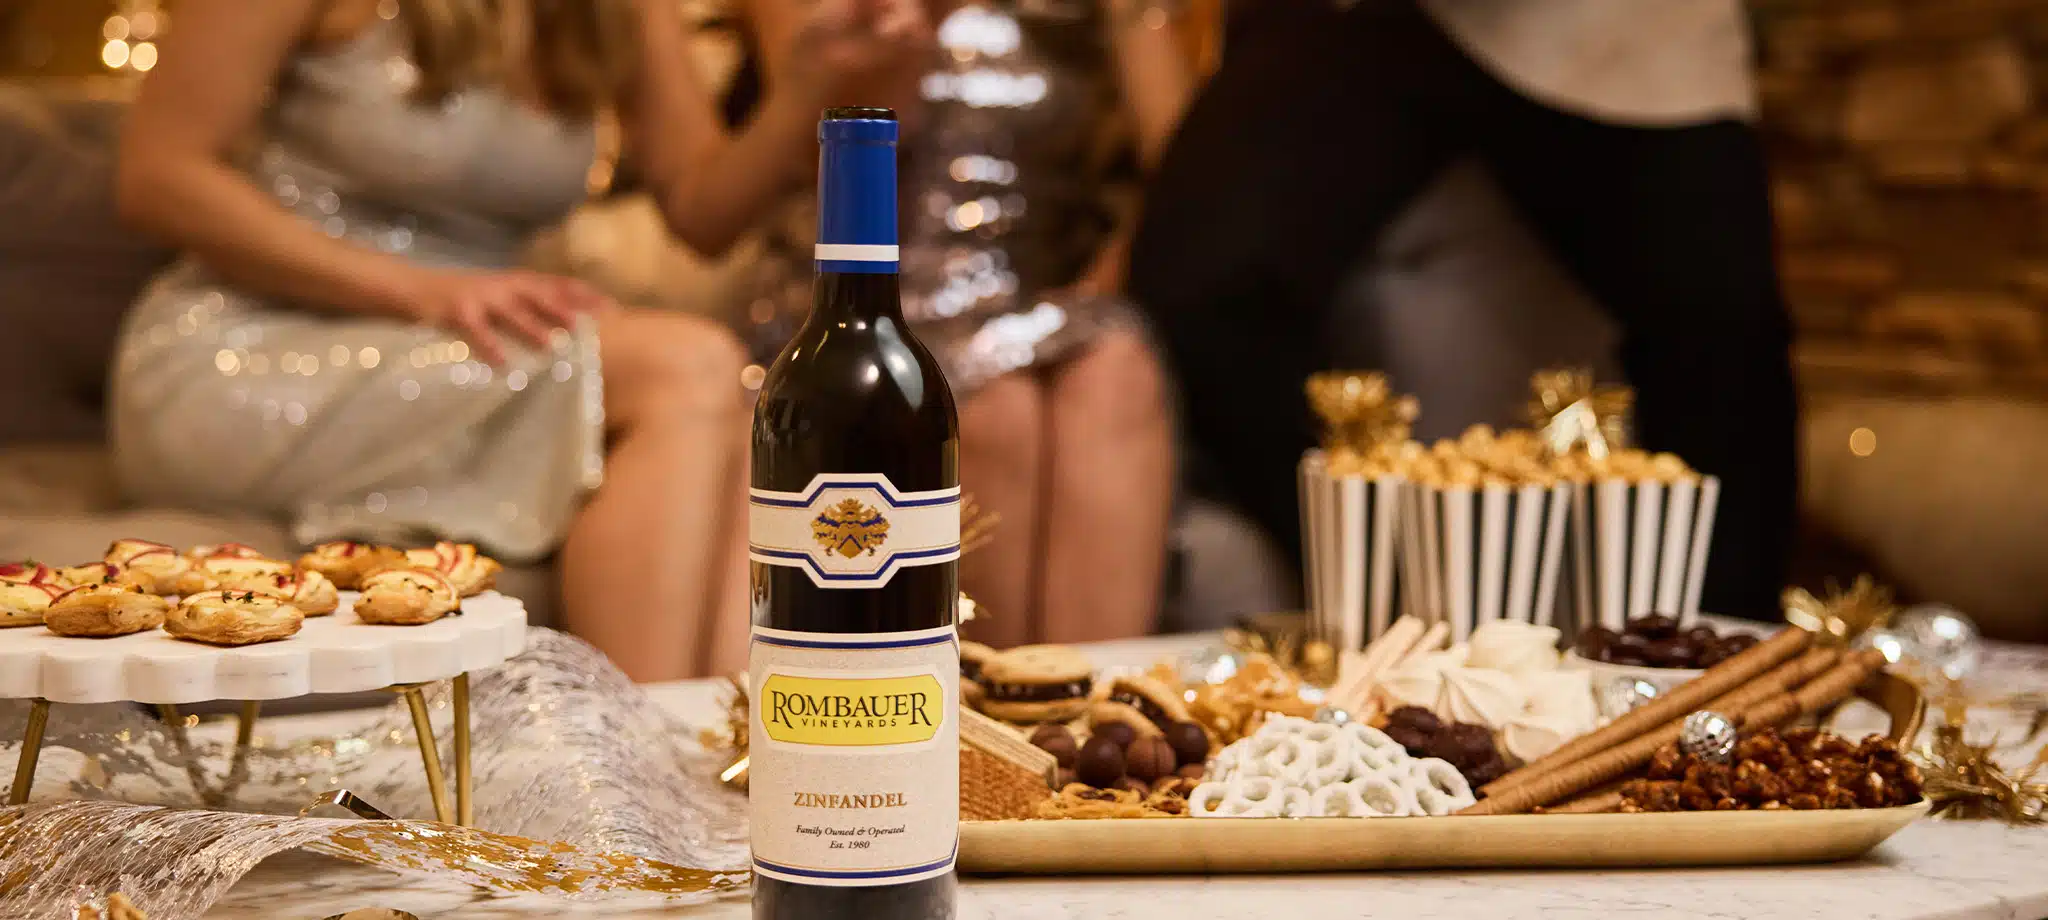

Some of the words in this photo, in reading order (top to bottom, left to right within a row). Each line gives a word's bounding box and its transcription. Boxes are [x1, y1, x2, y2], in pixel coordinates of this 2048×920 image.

[771, 690, 932, 729] ROMBAUER
[801, 718, 897, 729] VINEYARDS
[794, 792, 907, 809] ZINFANDEL
[795, 824, 823, 837] Family
[824, 826, 855, 836] Owned
[856, 826, 866, 836] &
[867, 824, 906, 838] Operated
[829, 840, 845, 849] Est.
[847, 840, 870, 849] 1980
